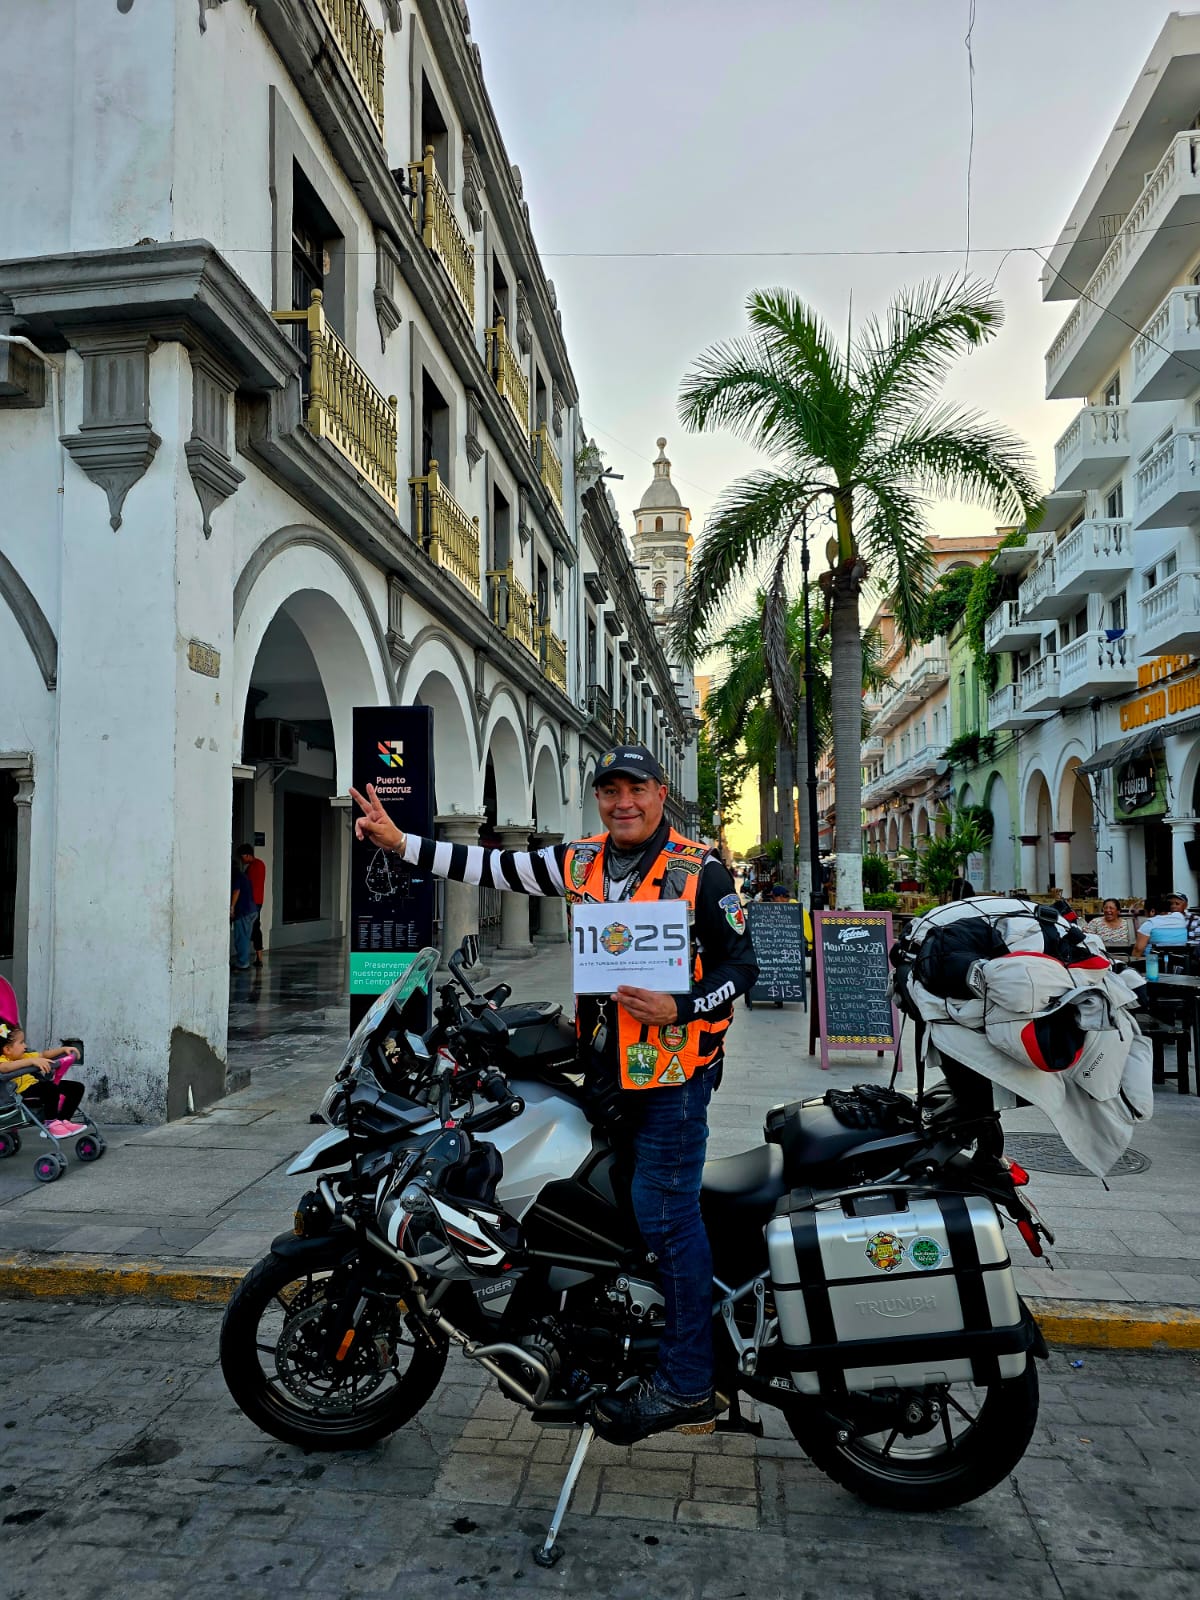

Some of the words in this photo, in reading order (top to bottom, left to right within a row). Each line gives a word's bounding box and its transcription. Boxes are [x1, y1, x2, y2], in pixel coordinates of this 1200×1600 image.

[1120, 690, 1166, 731] CONCHA
[1167, 674, 1200, 715] DORA
[376, 776, 406, 784] Puerto
[823, 941, 856, 953] MOJITOS
[364, 961, 410, 969] Preservemo
[365, 978, 390, 986] Centro
[767, 985, 803, 999] $155
[472, 1279, 512, 1298] TIGER
[855, 1295, 937, 1317] TRIUMPH
